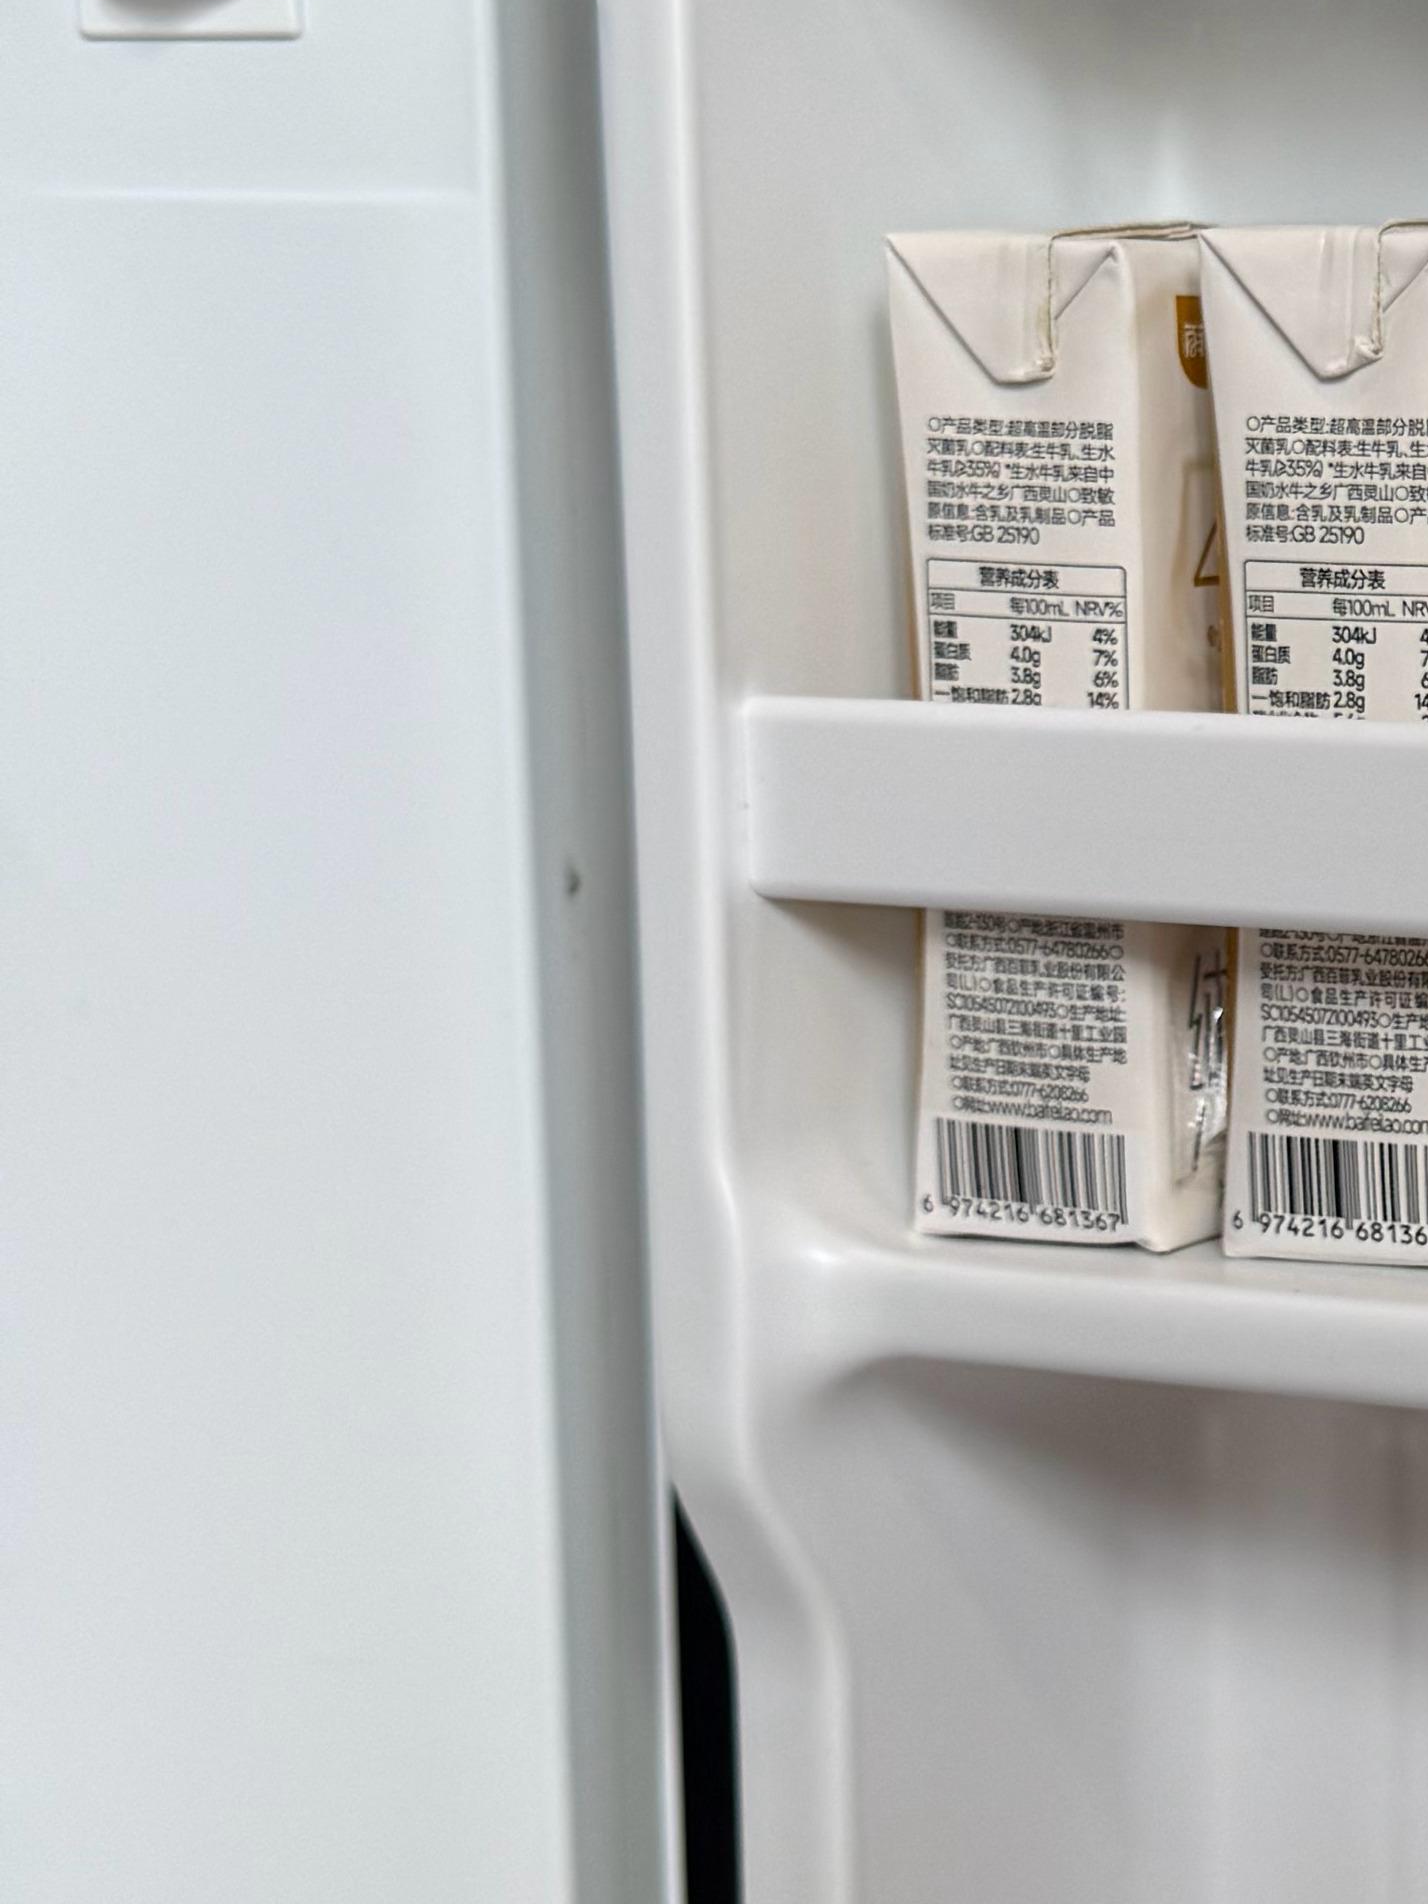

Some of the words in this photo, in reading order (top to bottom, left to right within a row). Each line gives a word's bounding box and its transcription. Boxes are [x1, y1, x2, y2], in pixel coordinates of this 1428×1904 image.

[923, 1194, 934, 1213] 6
[950, 1197, 1030, 1222] 974216
[1040, 1206, 1121, 1231] 681367
[1233, 1211, 1244, 1230] 6
[1260, 1213, 1345, 1239] 974216
